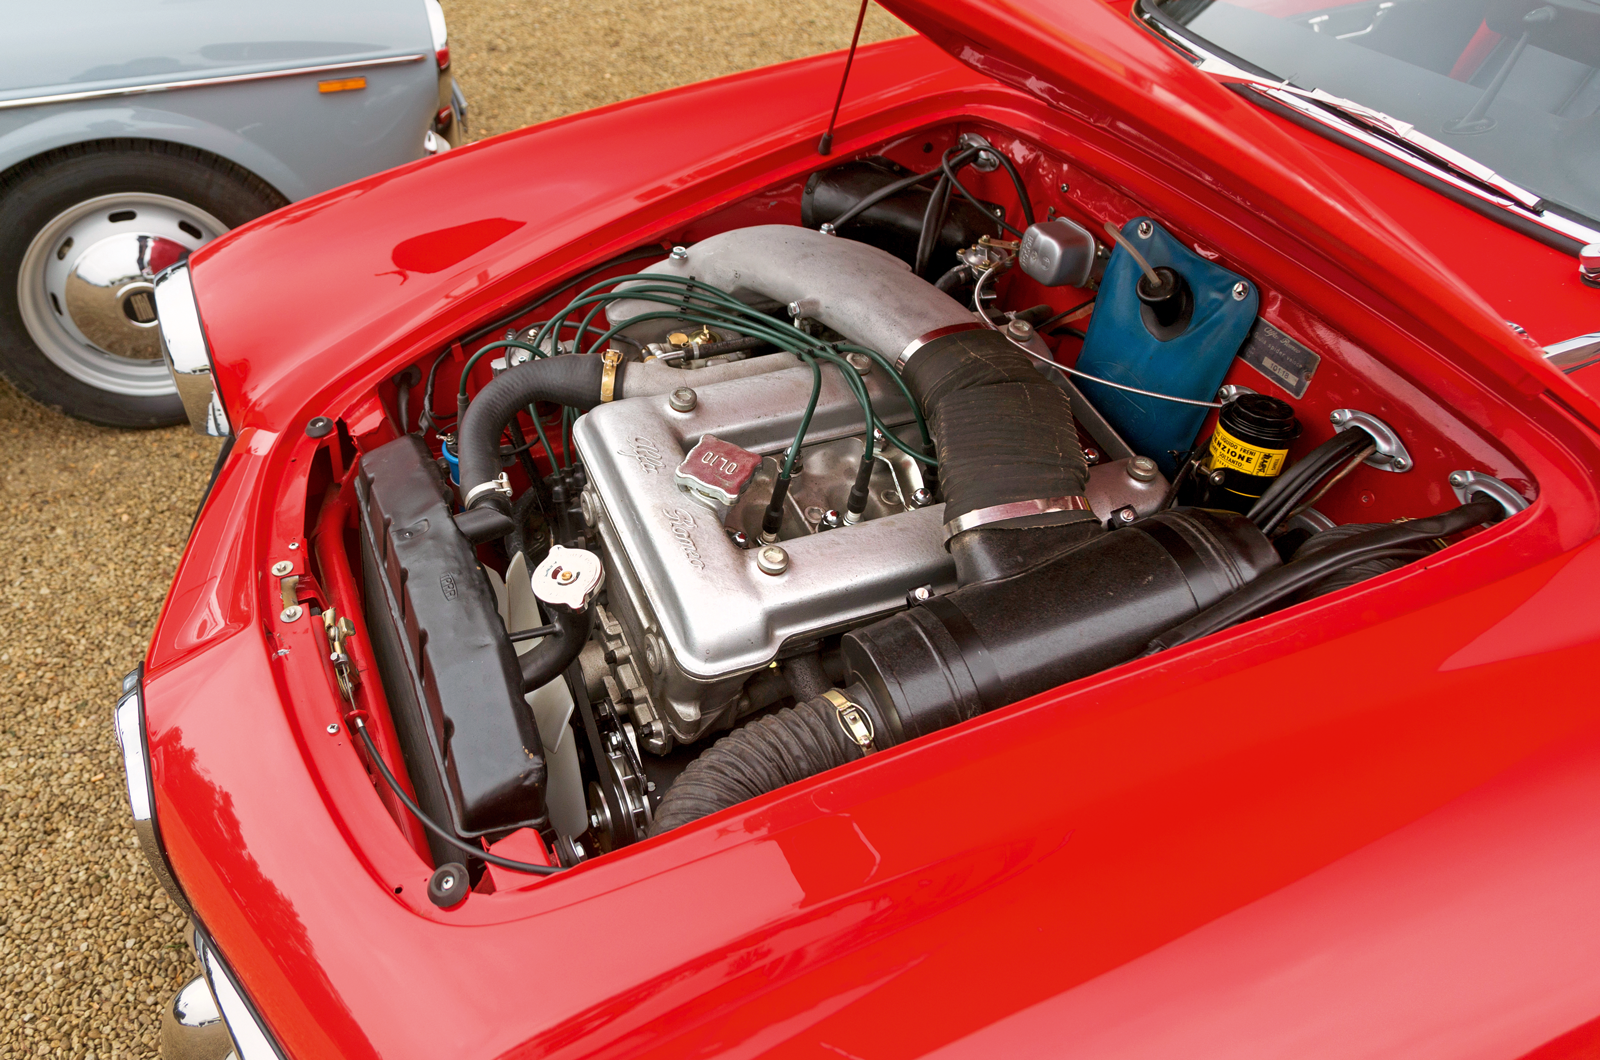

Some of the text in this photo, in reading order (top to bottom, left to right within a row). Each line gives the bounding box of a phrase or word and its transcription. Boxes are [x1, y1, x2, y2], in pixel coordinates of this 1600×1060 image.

[1264, 327, 1300, 353] Alfa Romeo
[1268, 344, 1286, 357] spider
[617, 436, 666, 474] Alfa
[701, 451, 738, 475] OLIO
[1240, 446, 1257, 457] FRENI
[663, 508, 706, 570] Romeo
